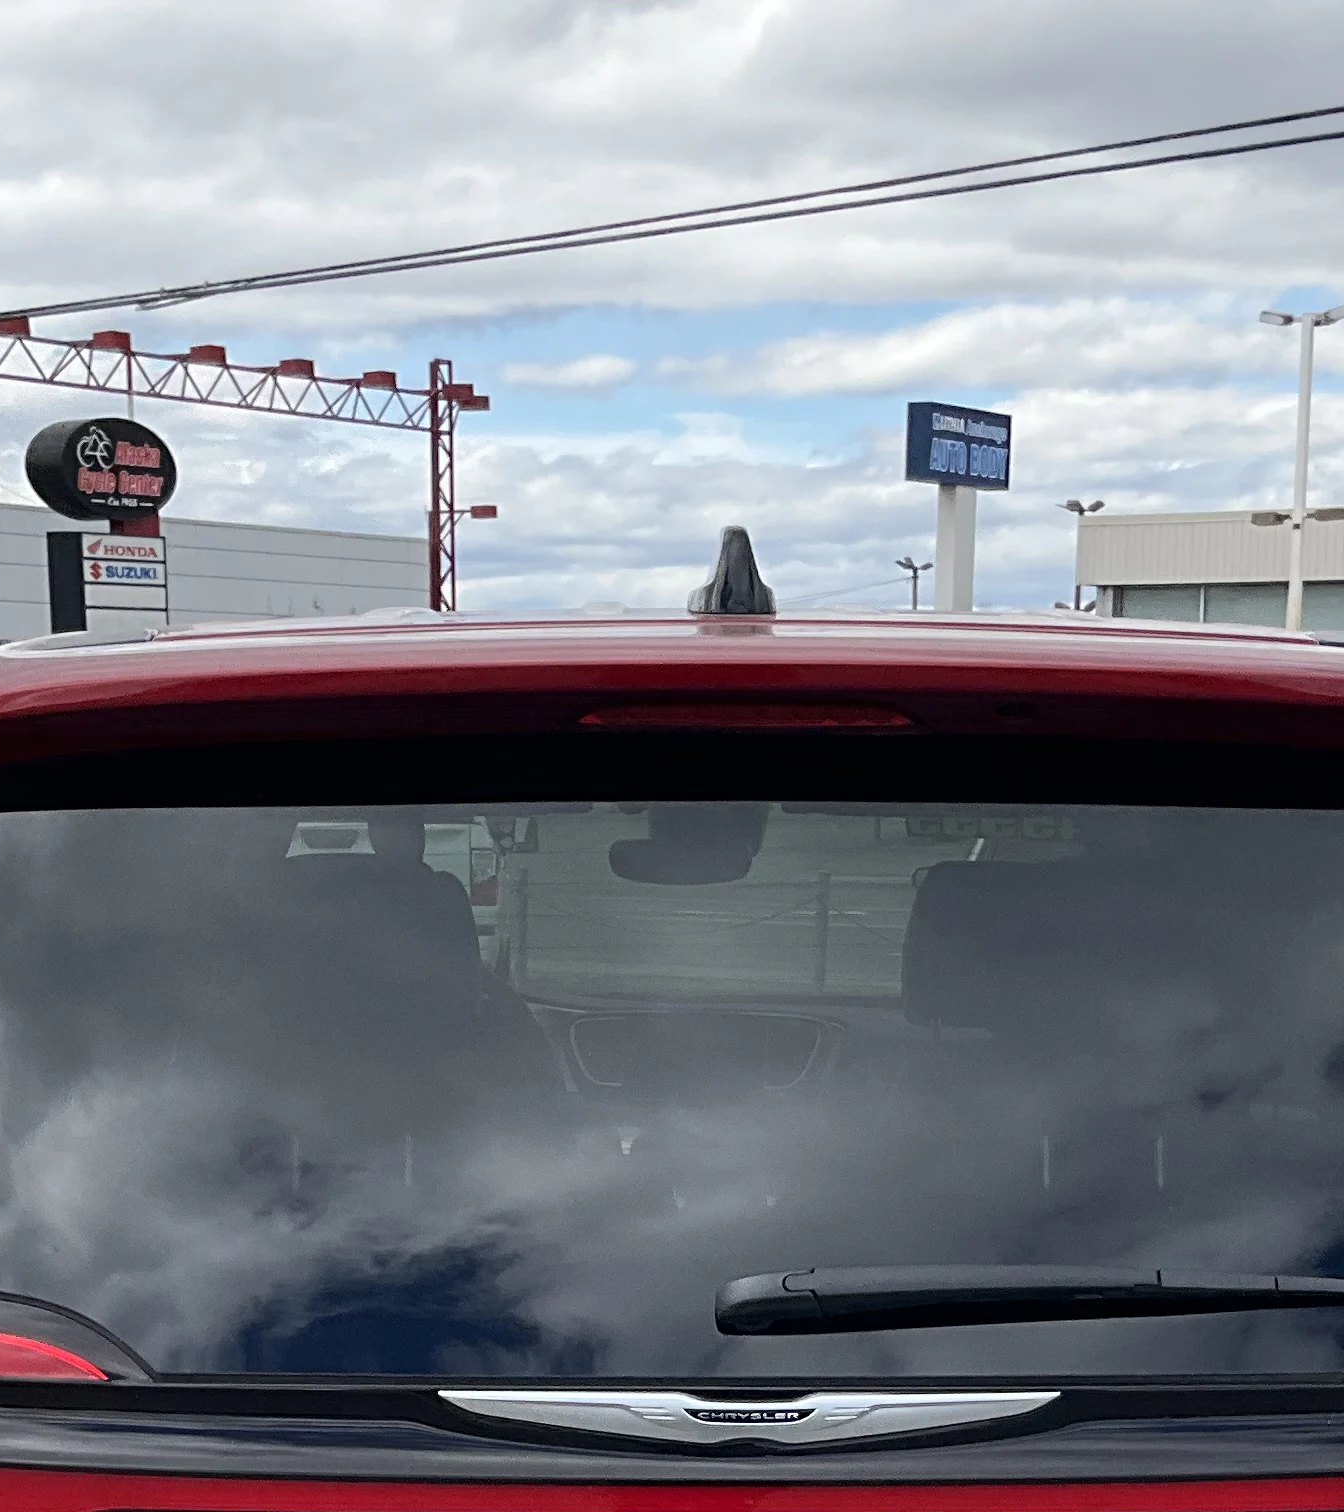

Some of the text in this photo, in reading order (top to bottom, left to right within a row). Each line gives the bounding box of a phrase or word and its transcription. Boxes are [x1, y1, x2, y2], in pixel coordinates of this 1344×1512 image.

[77, 467, 164, 497] Cycle Center
[103, 544, 159, 558] HONDA
[105, 565, 159, 580] SUZUKI
[697, 1412, 799, 1420] CHRYSLER
